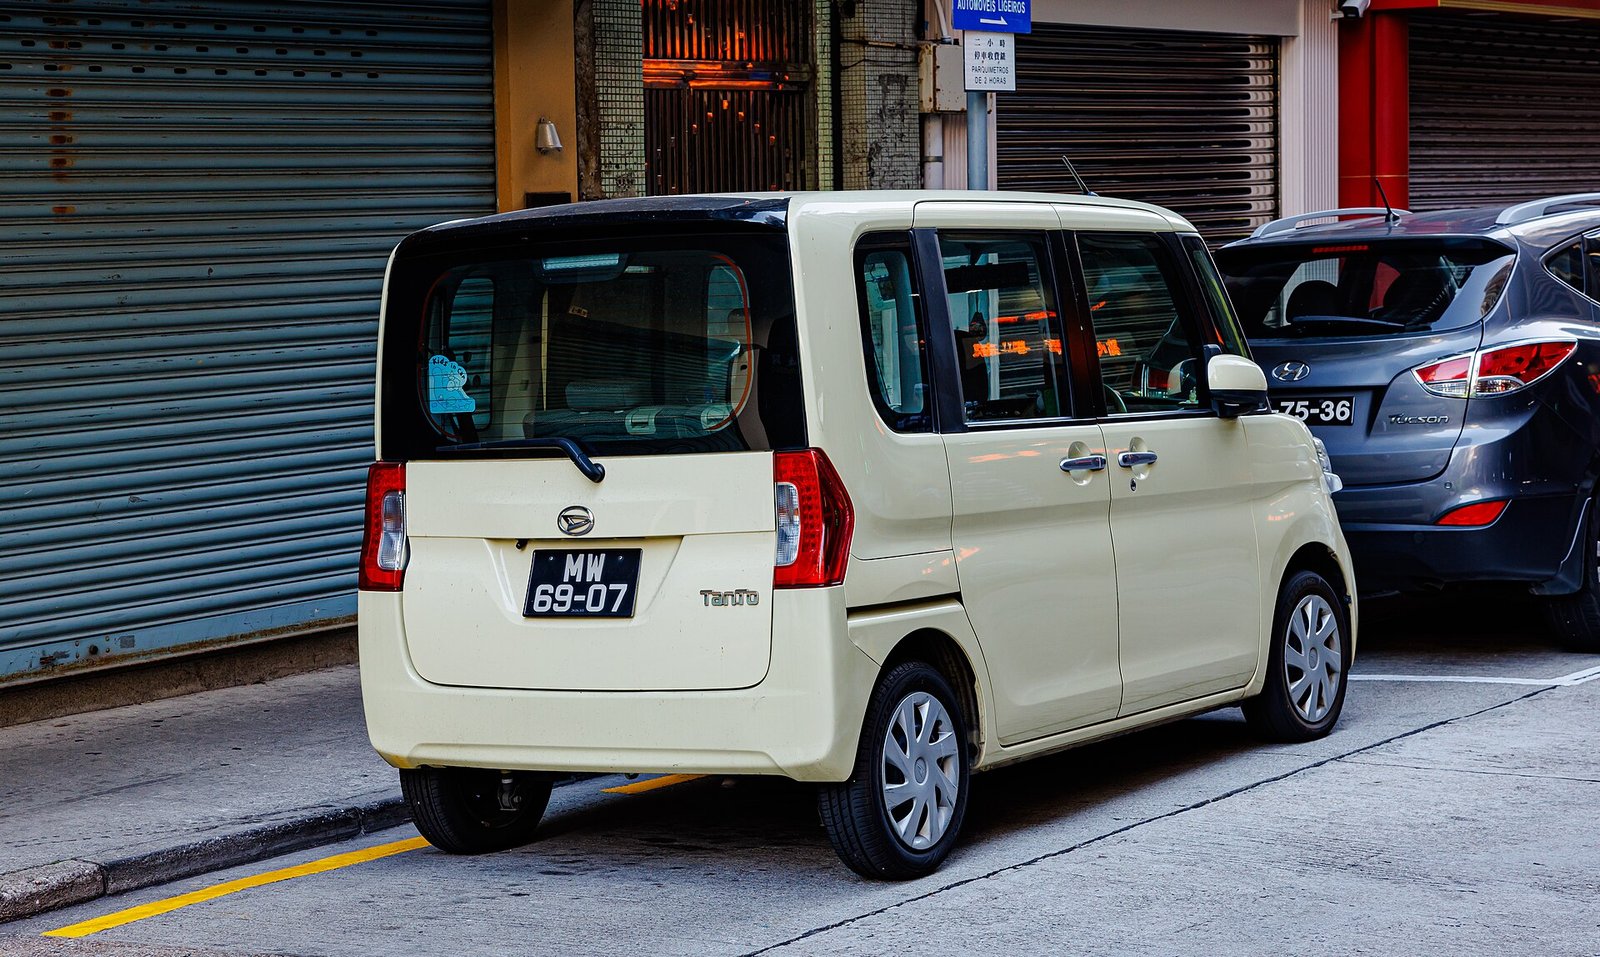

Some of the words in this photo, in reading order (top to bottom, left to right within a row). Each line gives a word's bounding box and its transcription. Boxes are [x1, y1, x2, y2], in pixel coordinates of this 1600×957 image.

[997, 1, 1026, 13] LIGEIROS
[974, 76, 982, 84] DE
[983, 76, 988, 84] 2
[988, 76, 1007, 85] HORAS
[563, 553, 606, 582] MW
[533, 583, 628, 612] 69-07
